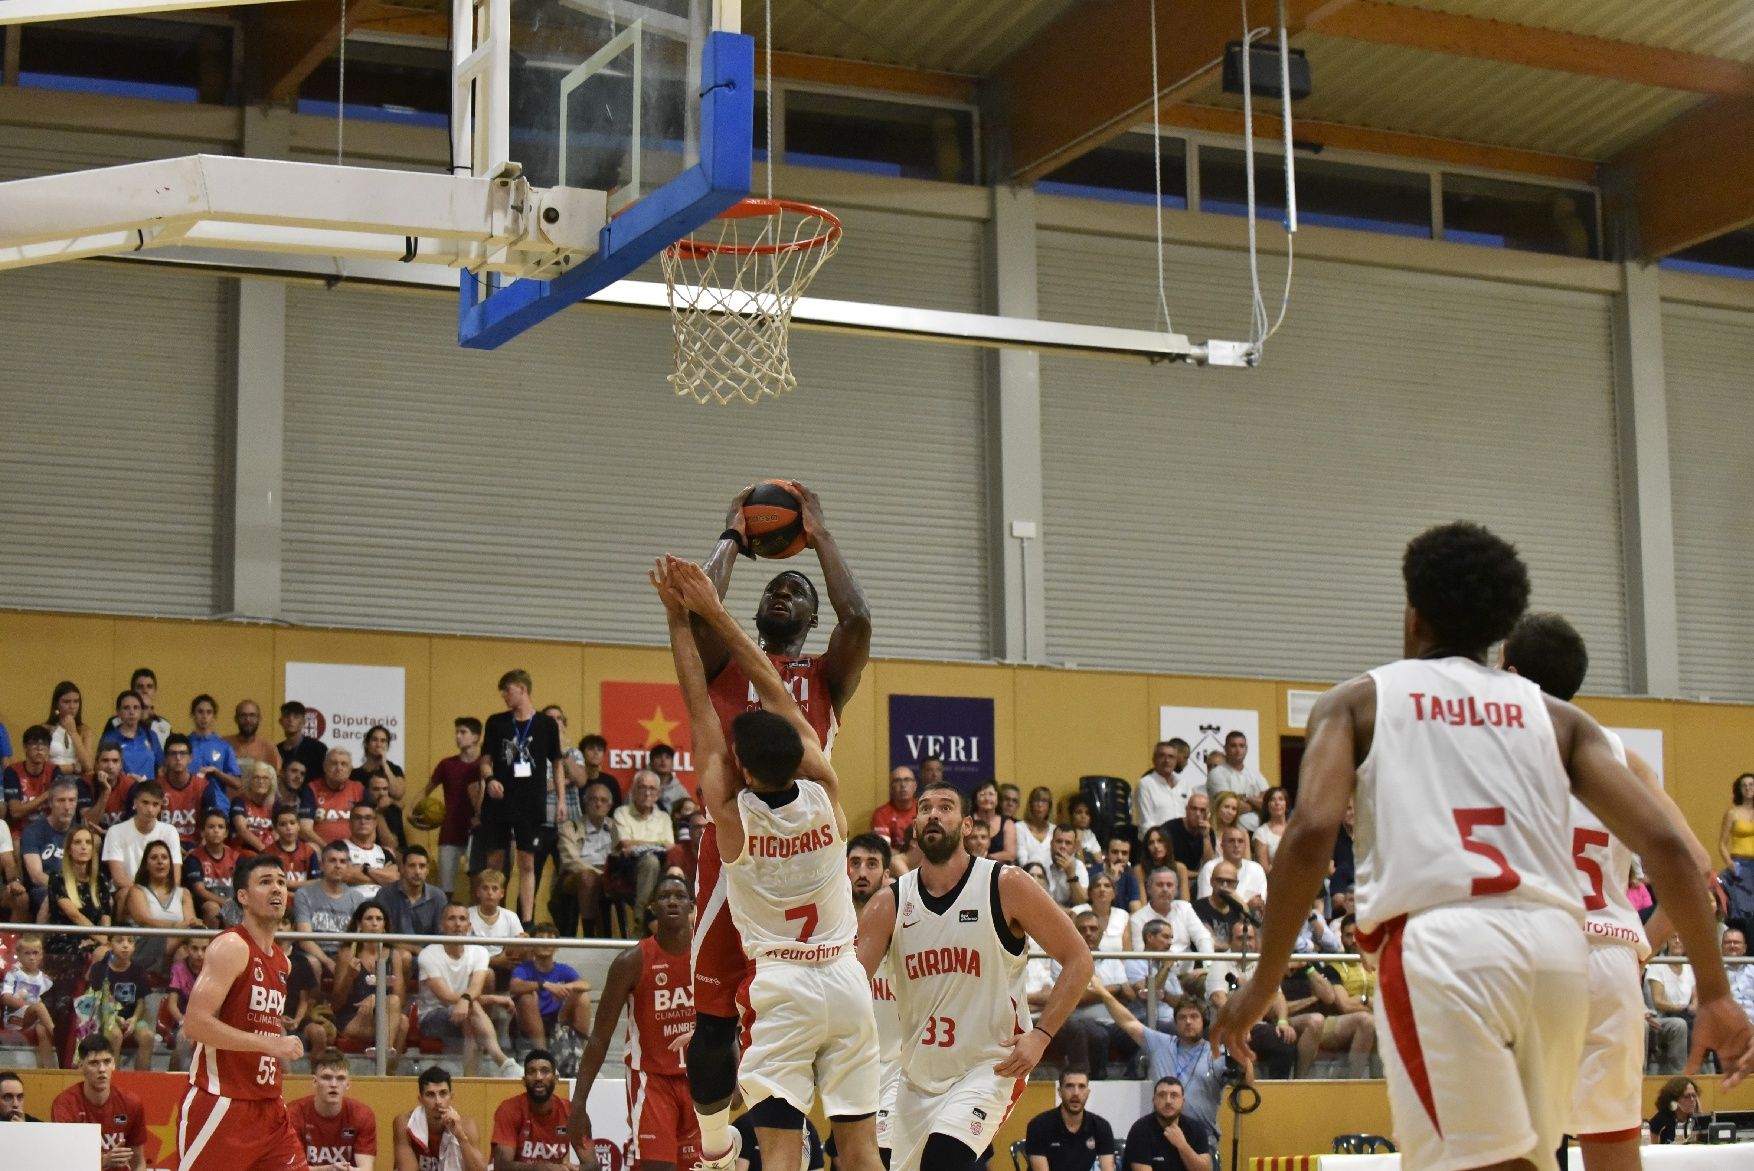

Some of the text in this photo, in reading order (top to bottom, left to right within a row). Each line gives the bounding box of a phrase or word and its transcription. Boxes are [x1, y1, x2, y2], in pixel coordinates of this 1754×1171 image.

[332, 713, 398, 727] Diputació
[1409, 693, 1525, 728] TAYLOR
[905, 734, 979, 762] VERI
[748, 824, 834, 858] FIGUERAS
[1453, 807, 1521, 896] 5
[784, 902, 819, 944] 7
[905, 947, 981, 981] GIRONA
[921, 1016, 956, 1048] 33
[256, 1055, 277, 1085] 55
